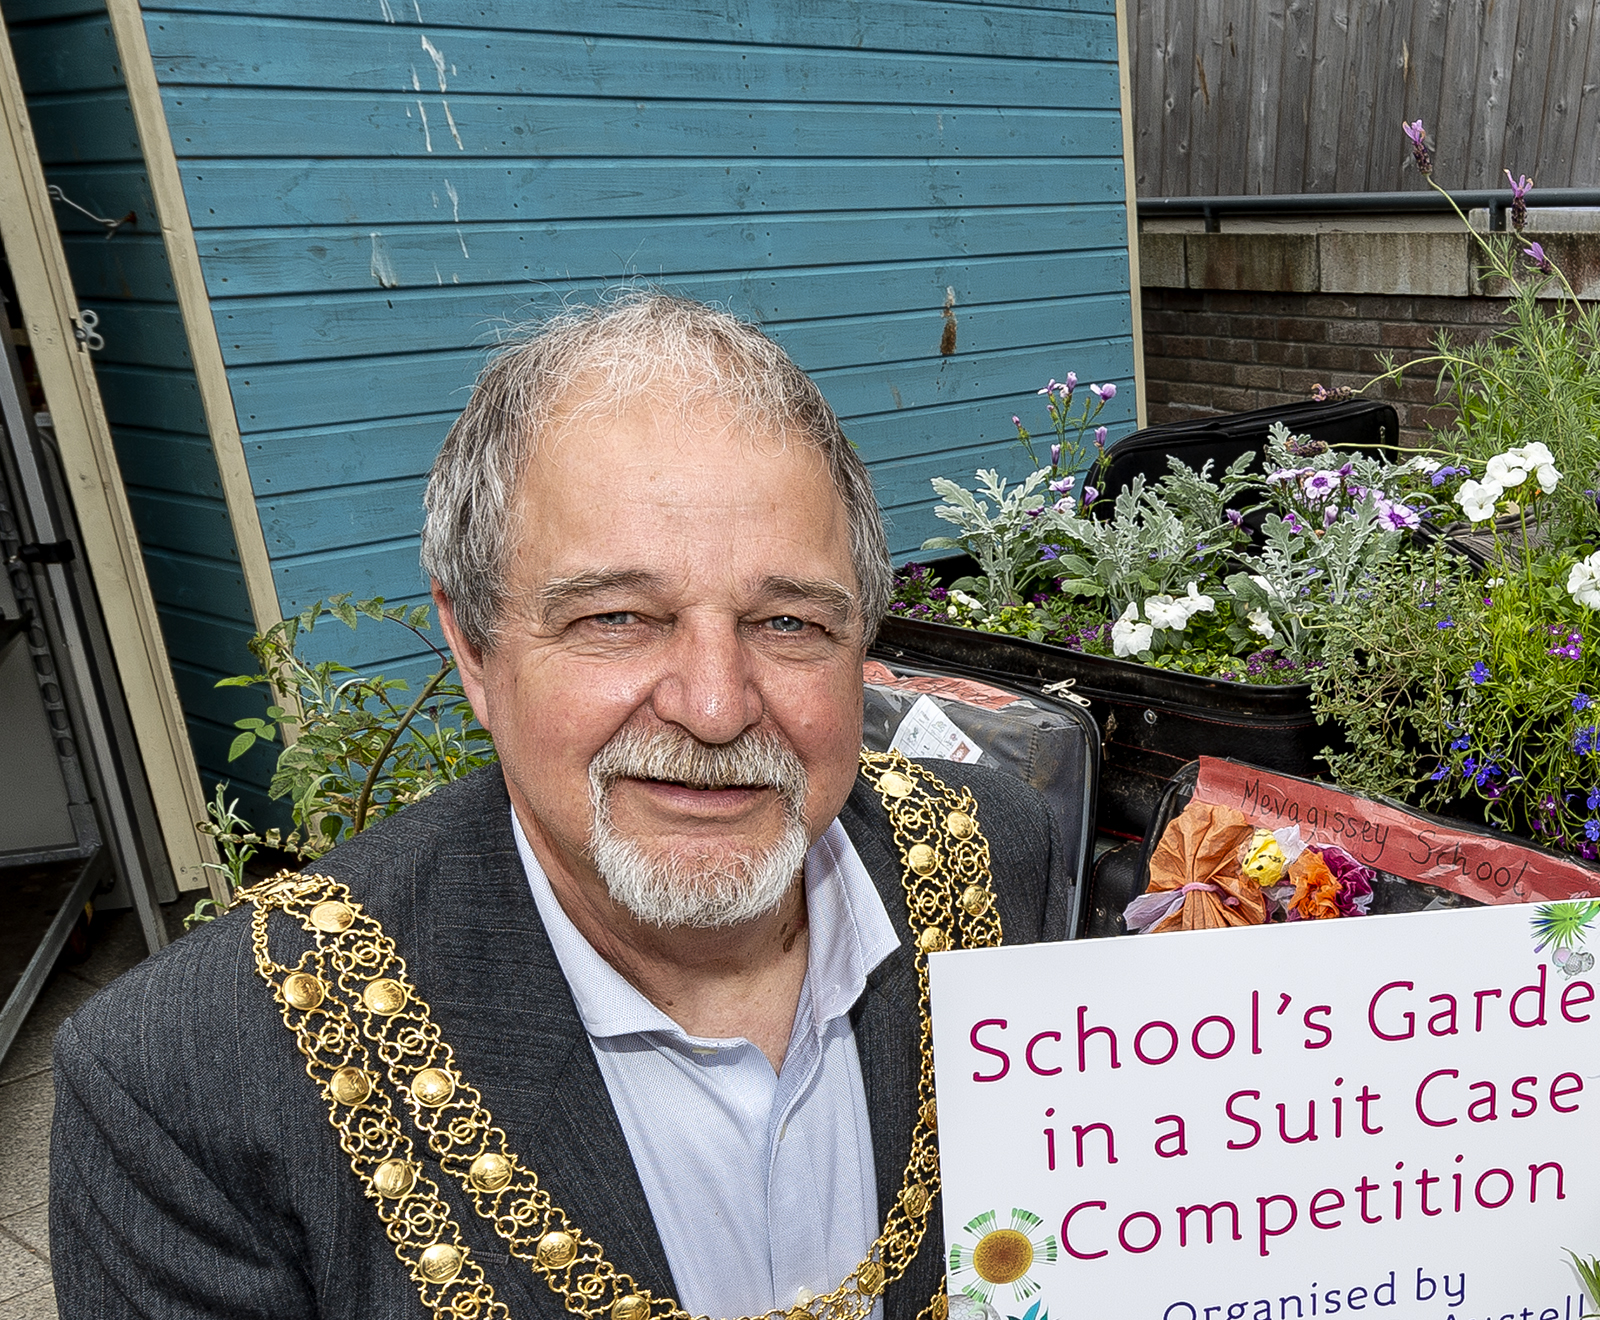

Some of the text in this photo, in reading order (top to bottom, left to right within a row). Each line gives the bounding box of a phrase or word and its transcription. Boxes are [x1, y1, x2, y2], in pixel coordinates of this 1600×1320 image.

[1242, 778, 1529, 898] Mevagissey School
[1042, 1067, 1585, 1171] in a Suit Case
[1059, 1154, 1567, 1261] Competition
[1415, 1267, 1467, 1308] by
